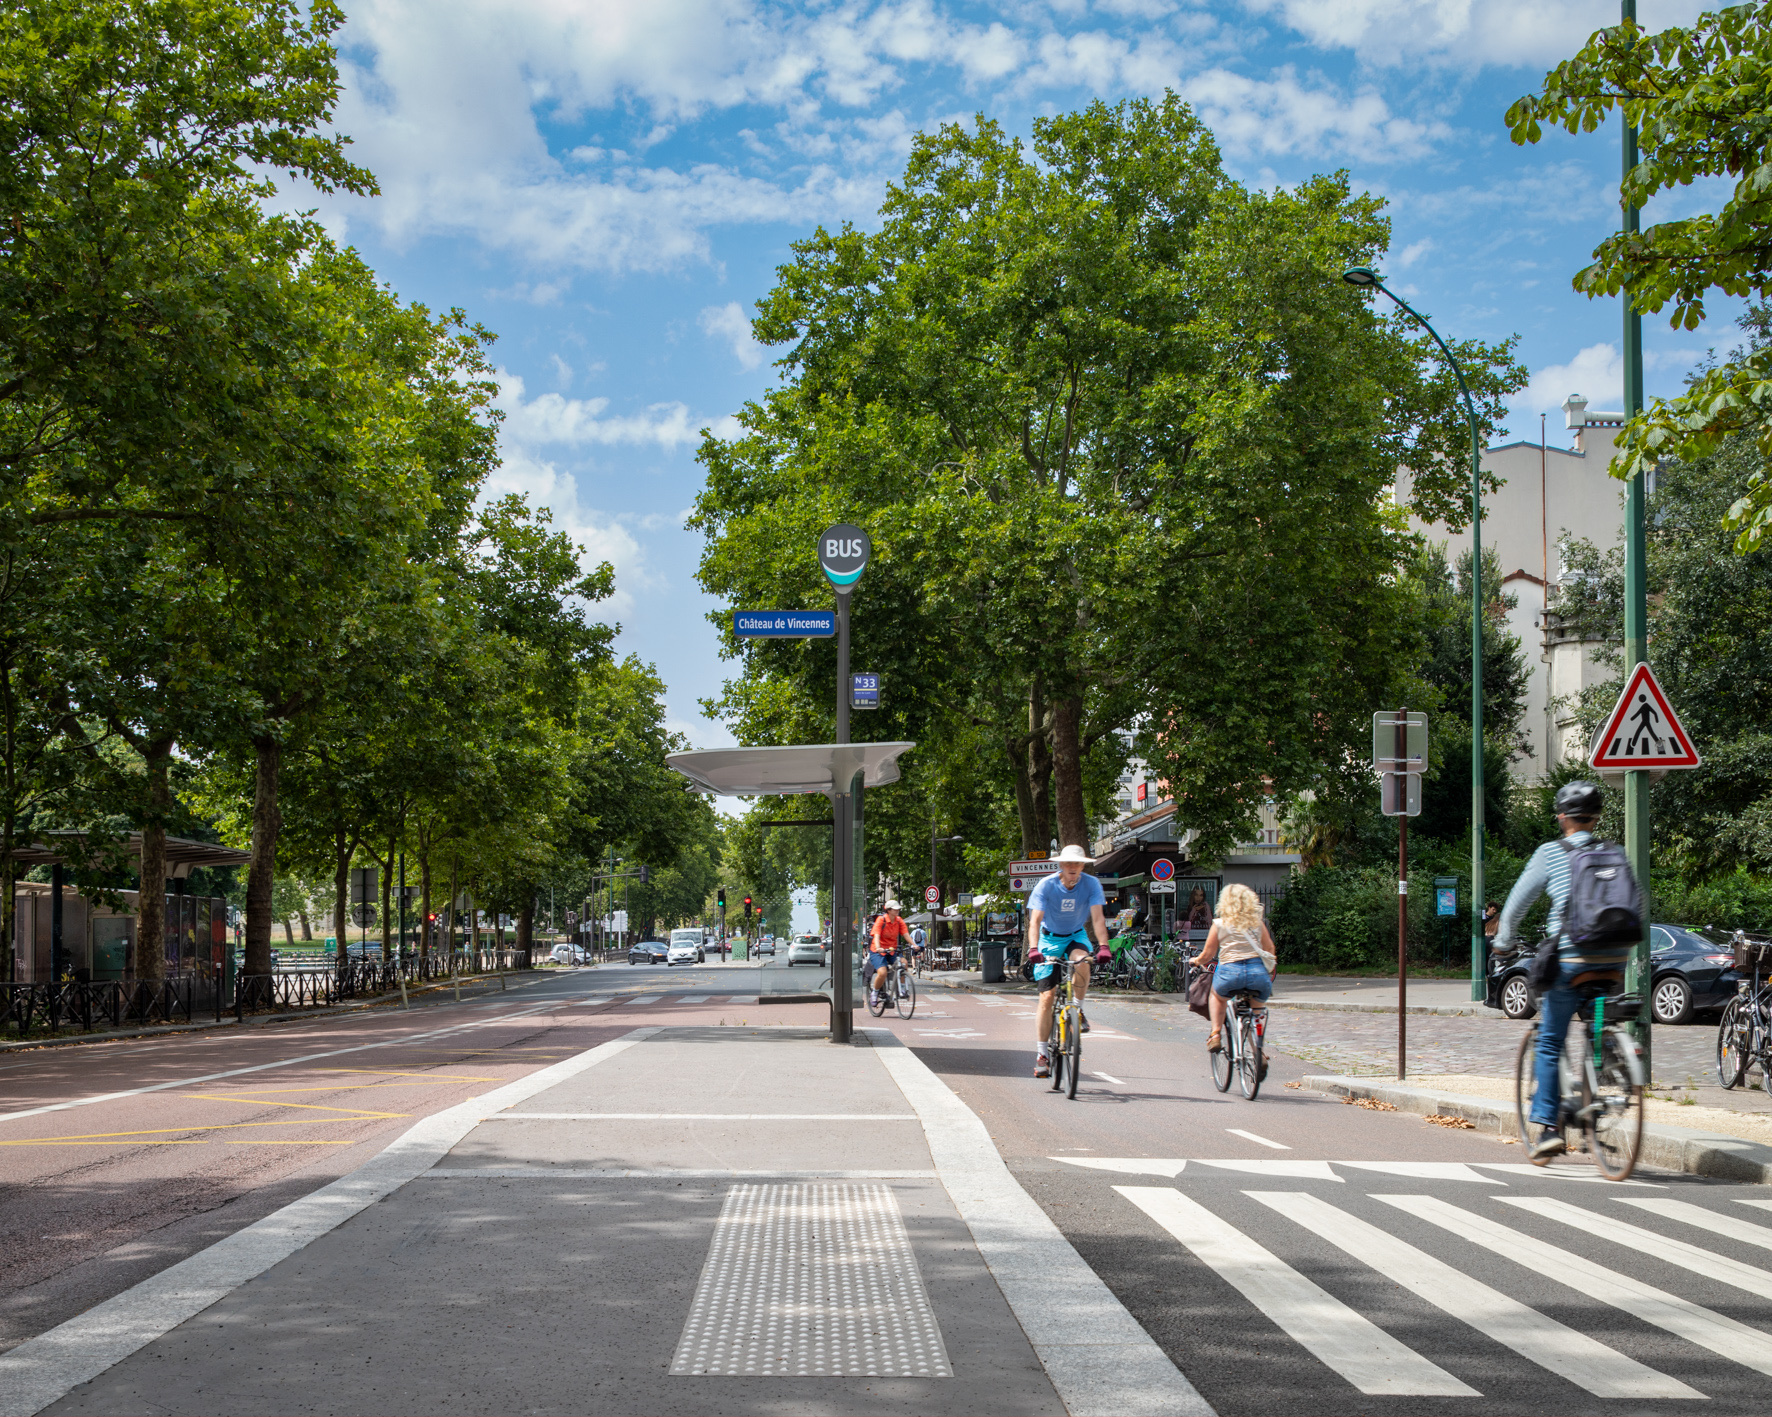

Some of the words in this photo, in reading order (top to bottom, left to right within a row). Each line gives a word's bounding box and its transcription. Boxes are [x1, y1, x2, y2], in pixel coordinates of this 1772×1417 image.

[826, 539, 862, 558] BUS
[738, 617, 773, 630] Château
[774, 618, 786, 630] de
[787, 617, 830, 629] Vincennes
[862, 678, 876, 688] 33
[1179, 881, 1213, 892] BAZAAR
[928, 890, 937, 899] 50
